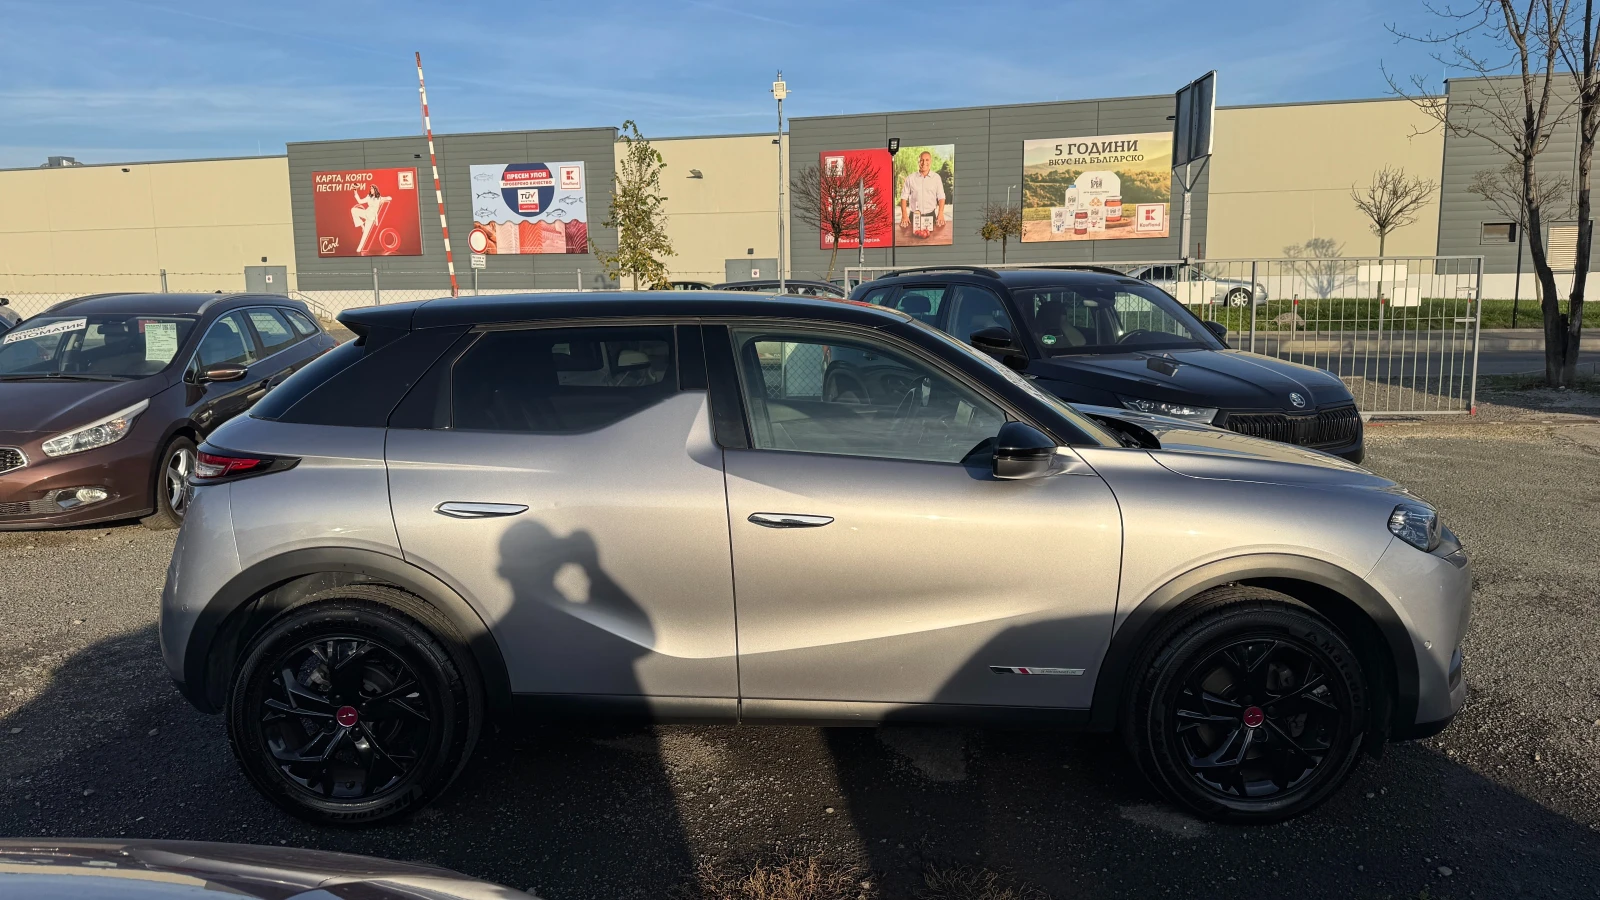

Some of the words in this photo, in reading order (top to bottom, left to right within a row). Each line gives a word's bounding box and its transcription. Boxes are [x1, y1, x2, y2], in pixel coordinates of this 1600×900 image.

[1054, 144, 1063, 156] 5
[1067, 139, 1138, 156] ГОДИНИ
[1048, 157, 1072, 166] ВКУС
[1074, 157, 1087, 165] НА
[1089, 154, 1144, 164] БЪЛГАРСКО
[315, 174, 344, 183] КАРТА,
[345, 172, 373, 182] КОЯТО
[506, 172, 530, 180] ПРЕСЕН
[316, 183, 342, 192] ПЕСТИ
[322, 236, 340, 252] Card
[5, 322, 84, 344] АВТОМАТИК
[1320, 641, 1362, 711] Matador
